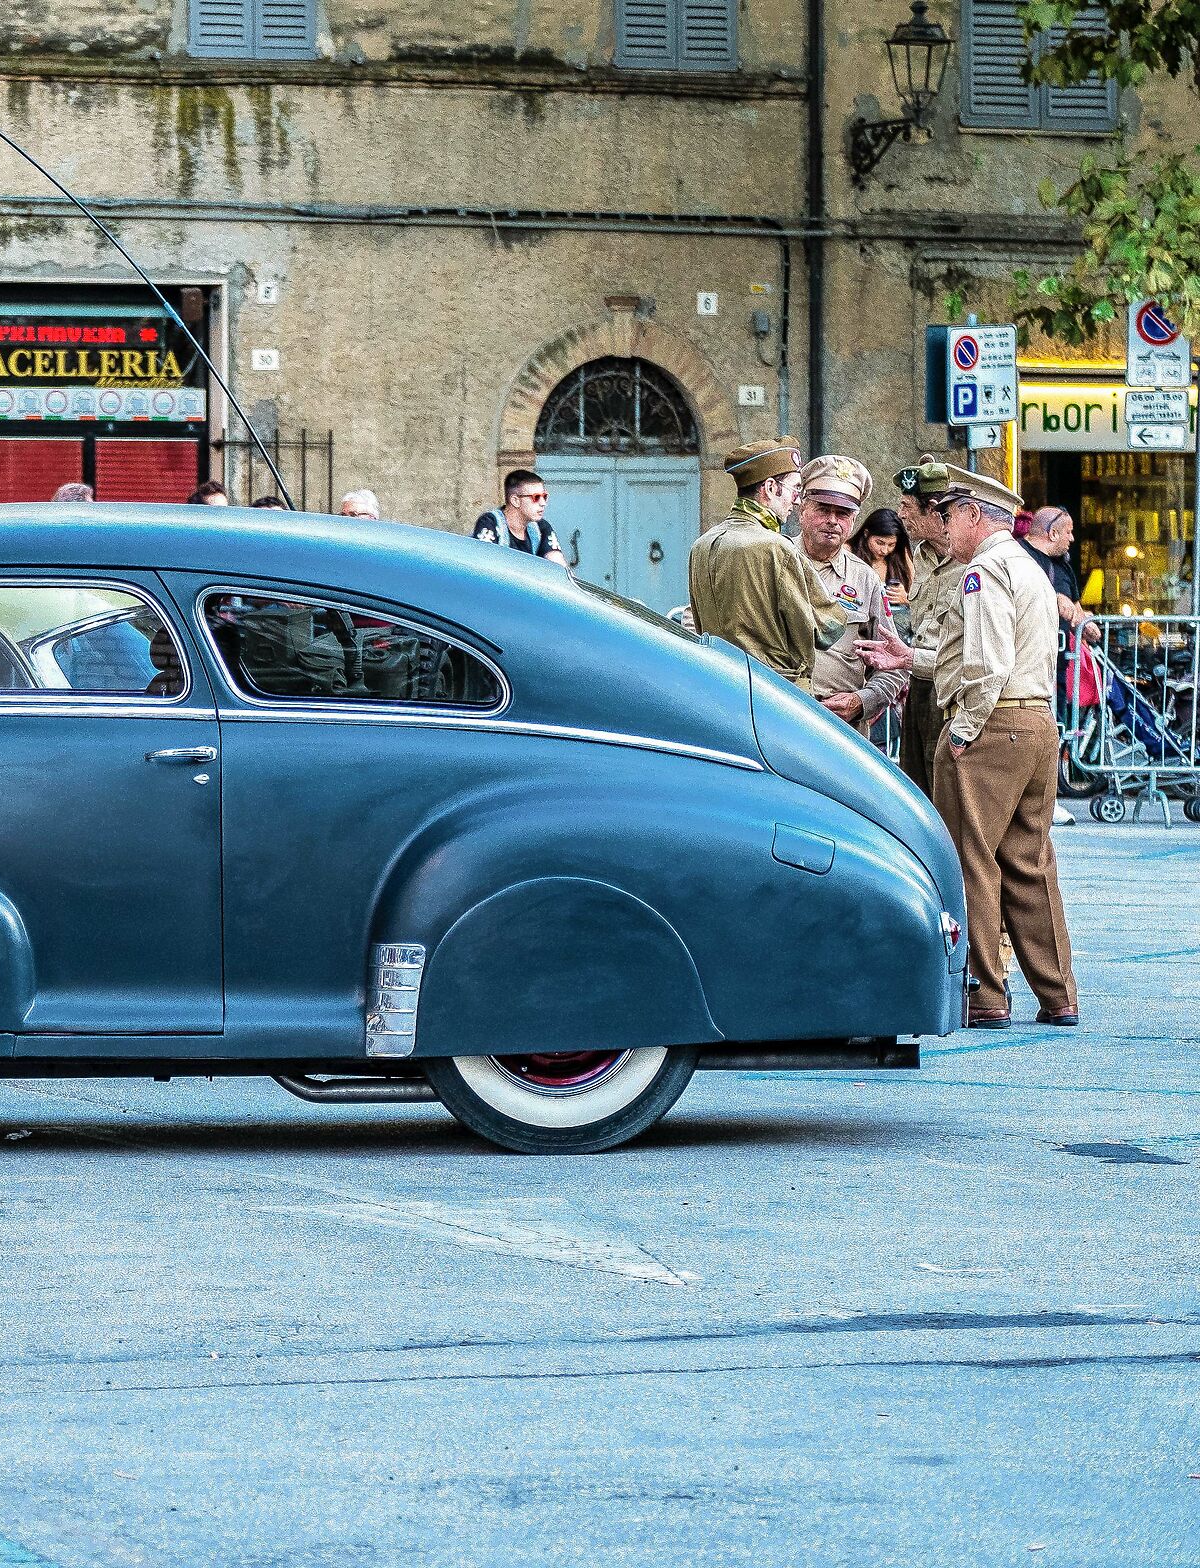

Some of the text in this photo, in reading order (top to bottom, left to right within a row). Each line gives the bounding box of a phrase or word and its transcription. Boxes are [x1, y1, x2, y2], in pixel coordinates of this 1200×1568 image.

[703, 297, 712, 311] 6
[746, 391, 757, 401] 31
[958, 387, 974, 414] P
